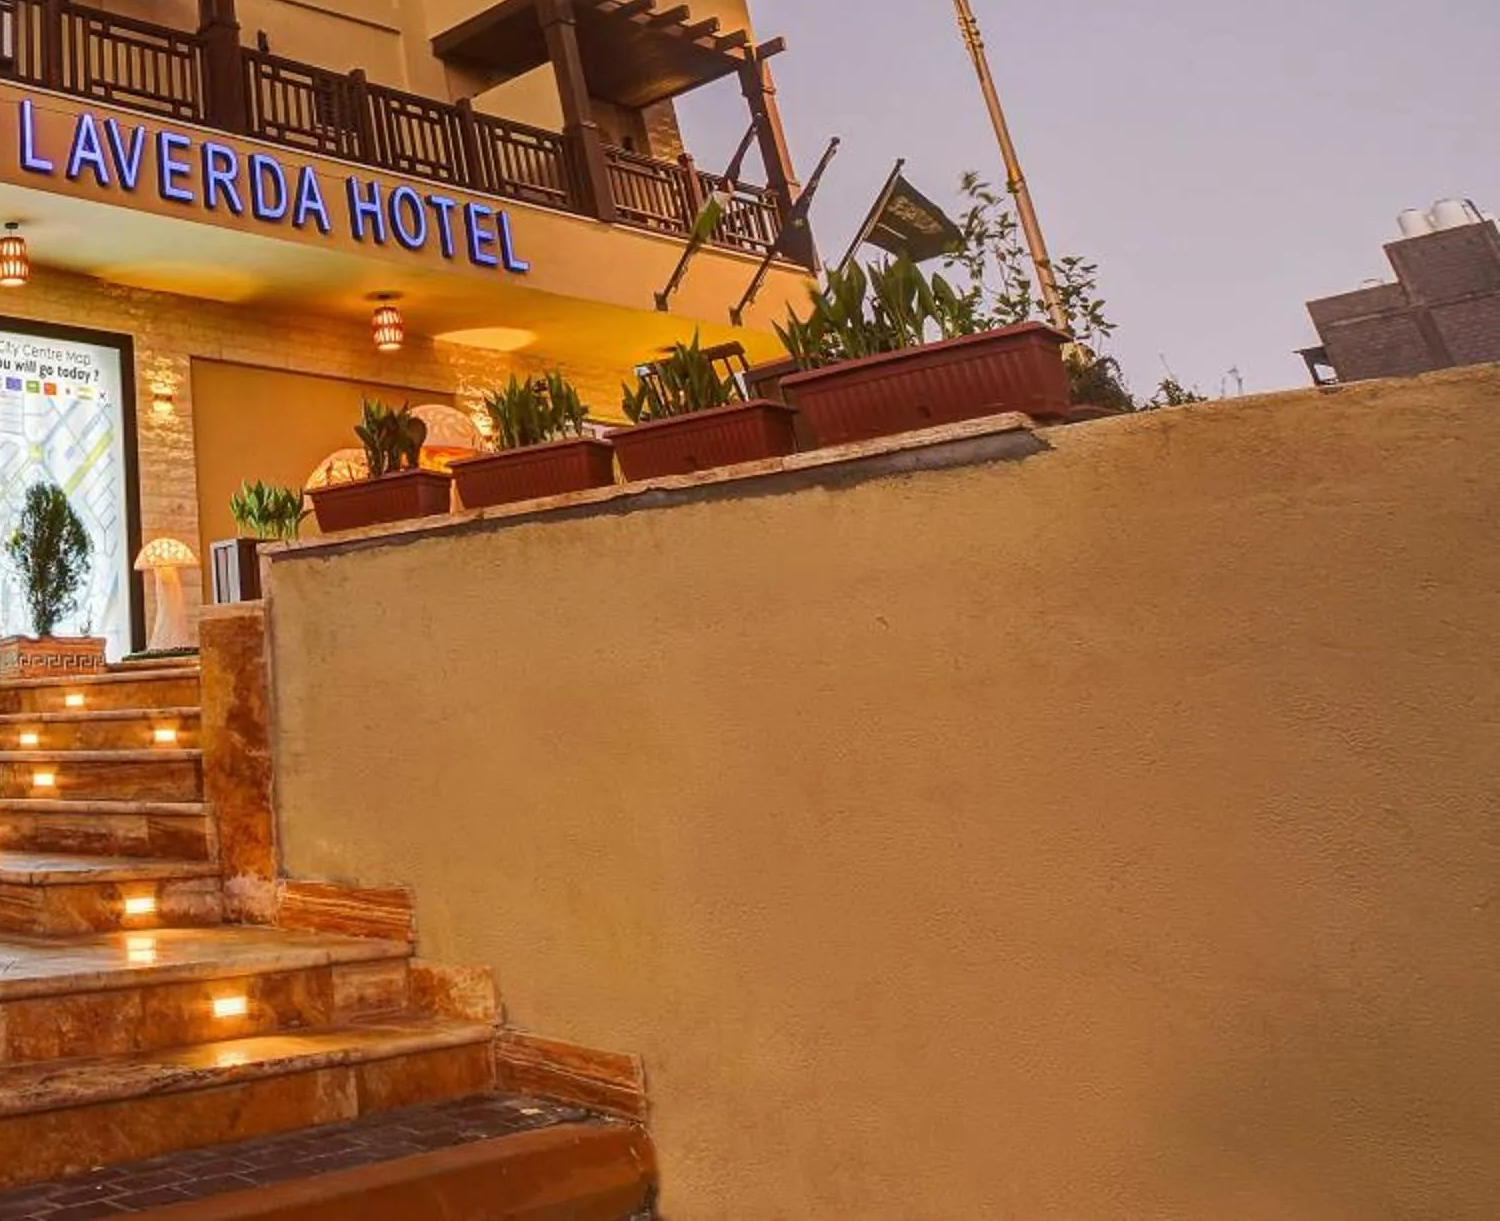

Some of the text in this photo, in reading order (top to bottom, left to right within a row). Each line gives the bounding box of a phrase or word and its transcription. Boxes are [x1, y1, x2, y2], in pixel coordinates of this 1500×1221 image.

[18, 99, 332, 234] LAVERDA
[345, 176, 531, 273] HOTEL
[23, 344, 63, 362] Centre
[66, 350, 92, 366] Map
[15, 360, 37, 374] will
[39, 364, 54, 379] go
[57, 366, 93, 384] today
